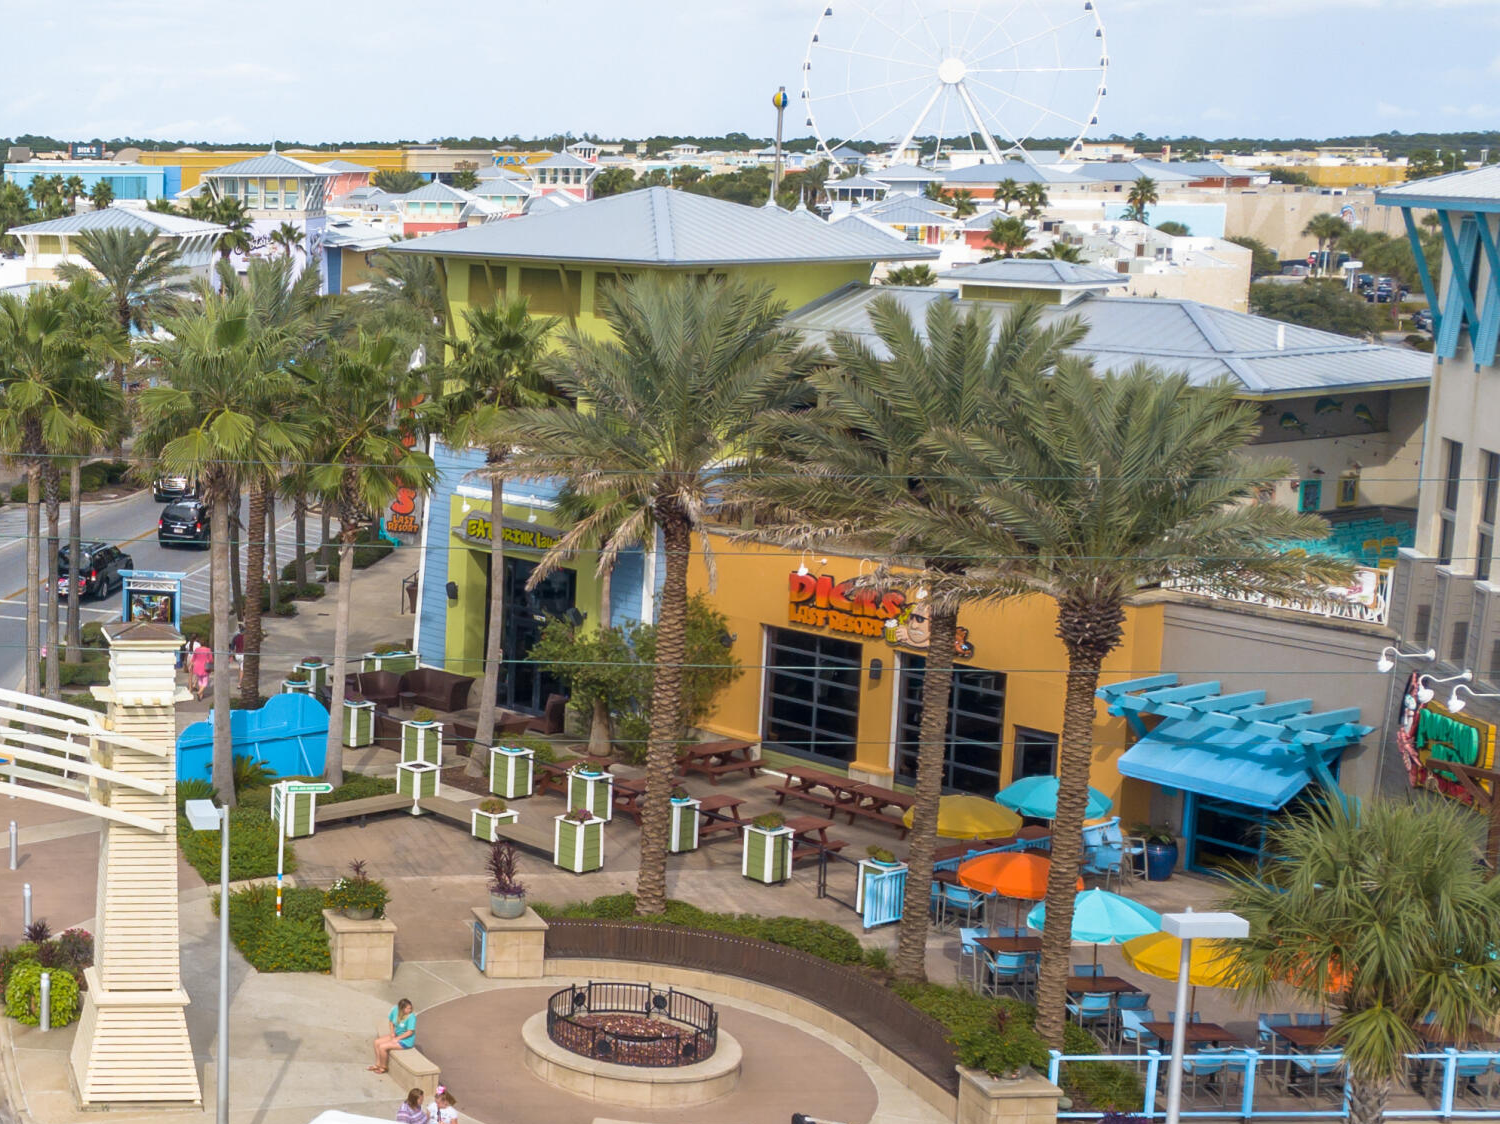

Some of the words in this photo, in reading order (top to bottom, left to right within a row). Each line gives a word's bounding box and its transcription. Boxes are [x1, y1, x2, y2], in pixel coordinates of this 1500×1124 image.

[392, 514, 416, 525] LAST
[386, 521, 420, 534] RESORT
[788, 602, 827, 627] LAST
[827, 609, 886, 637] RESORT
